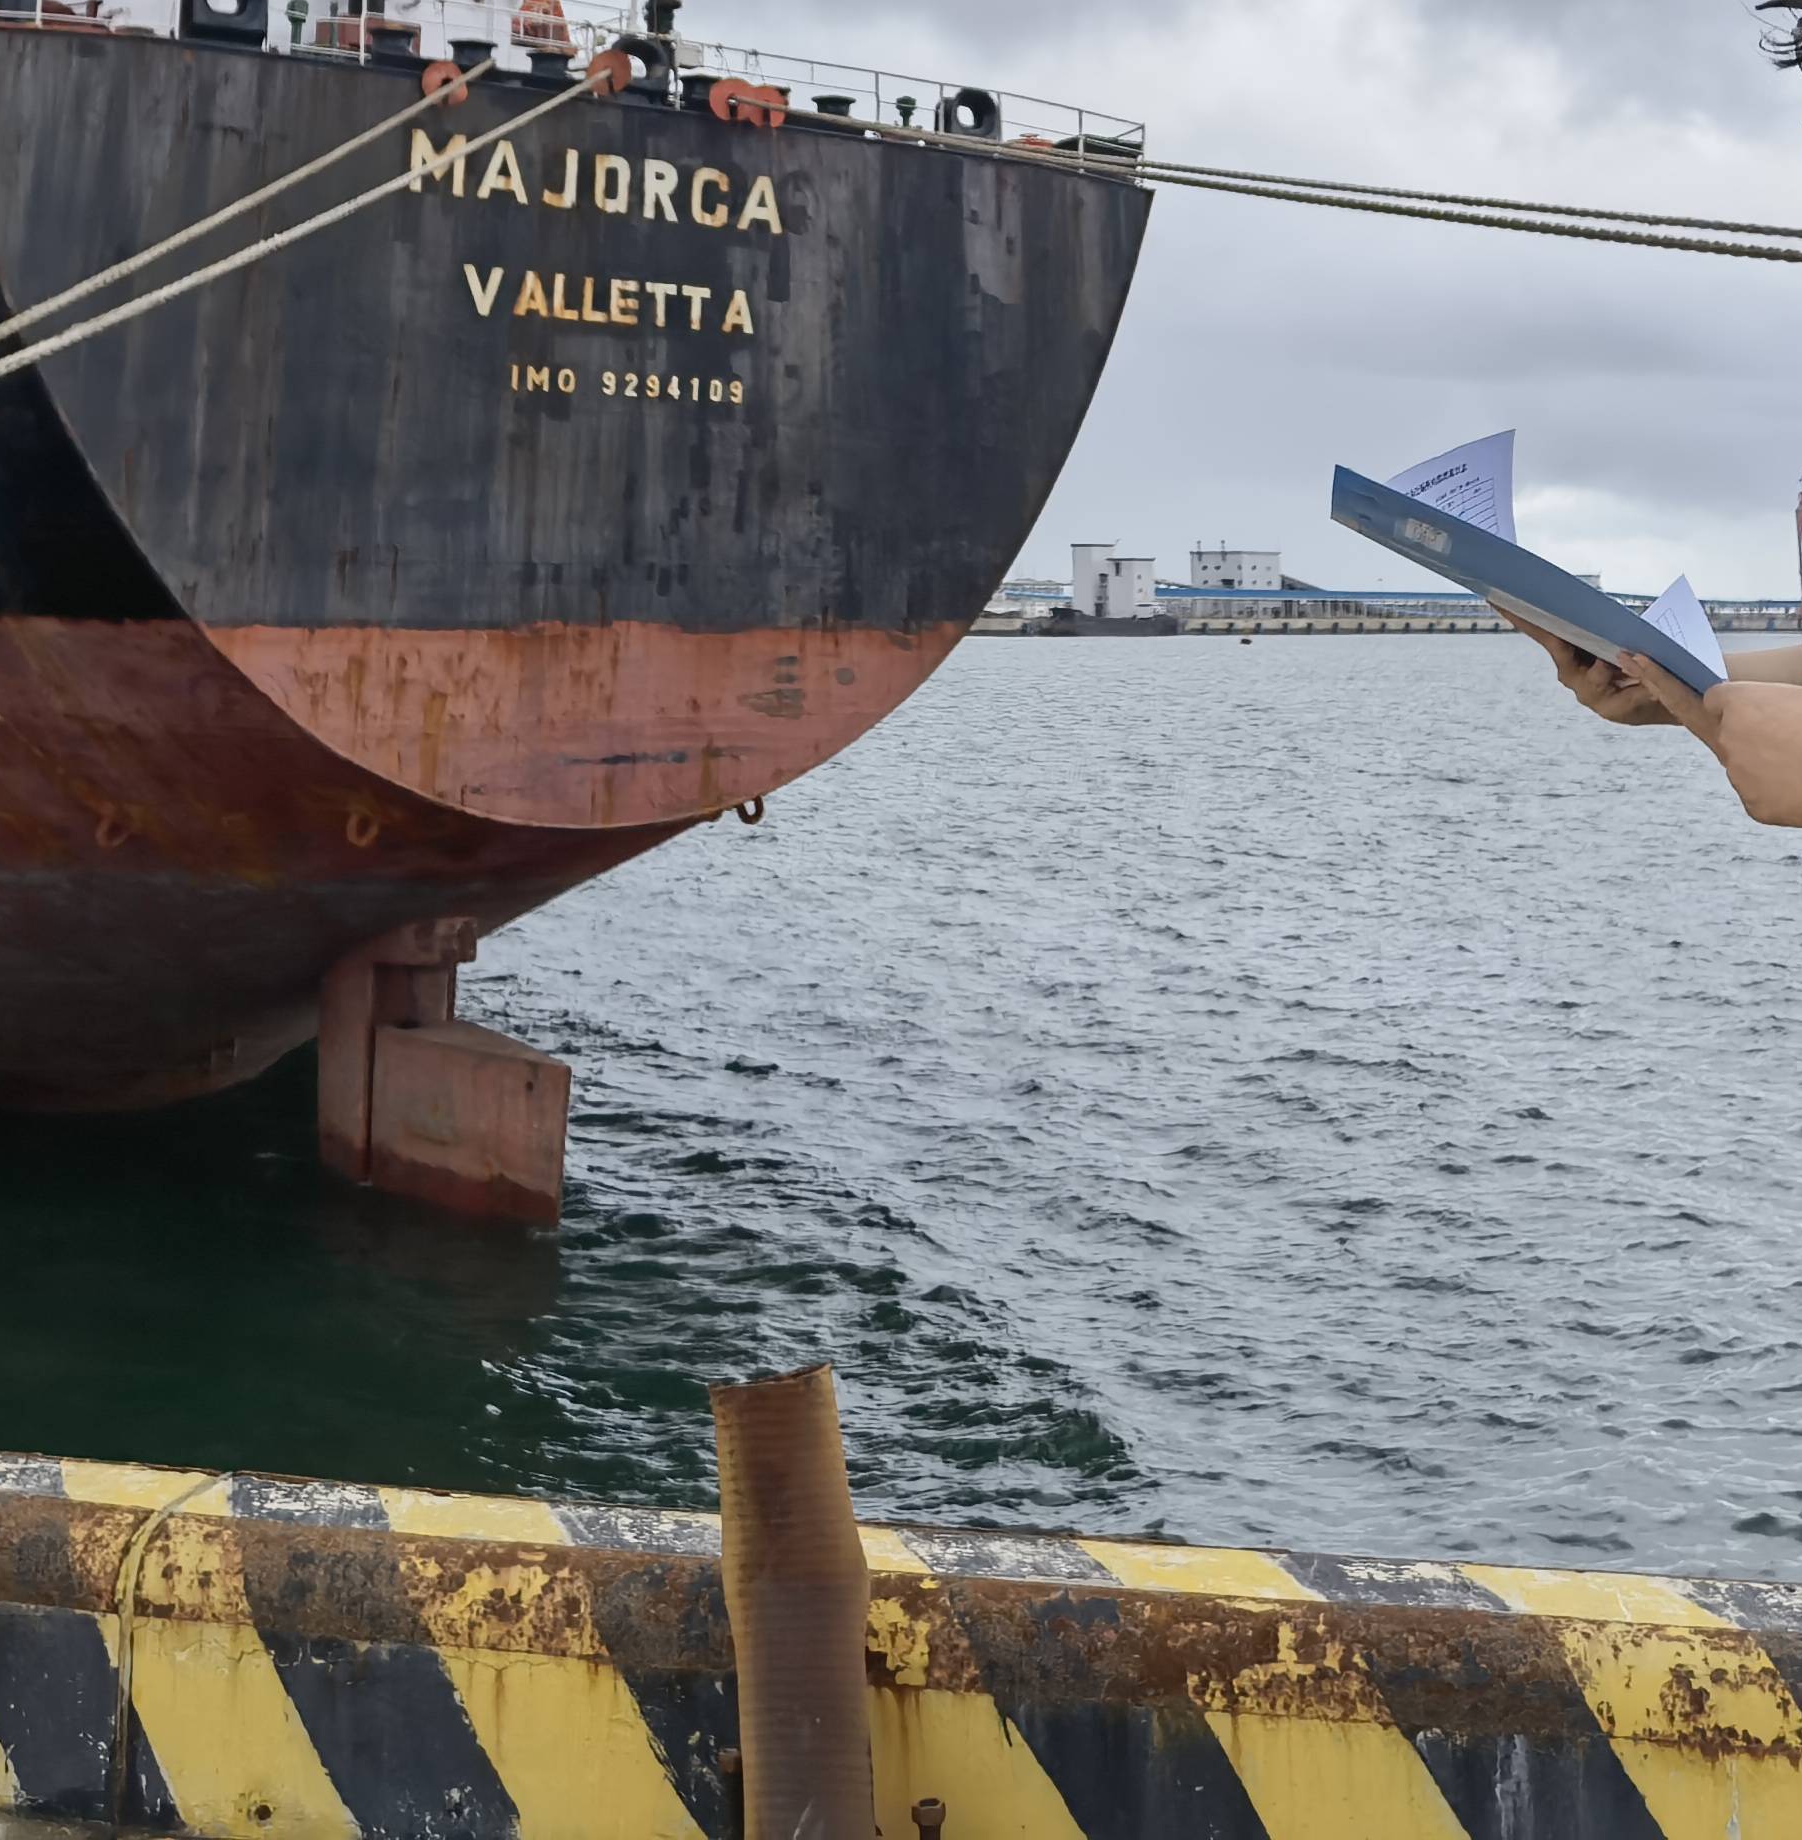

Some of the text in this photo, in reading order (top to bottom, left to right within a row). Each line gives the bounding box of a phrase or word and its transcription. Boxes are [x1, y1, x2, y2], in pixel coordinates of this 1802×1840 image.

[409, 128, 783, 235] MAJORCA
[463, 263, 755, 336] VALLETTA
[511, 365, 744, 405] IMO 9294109
